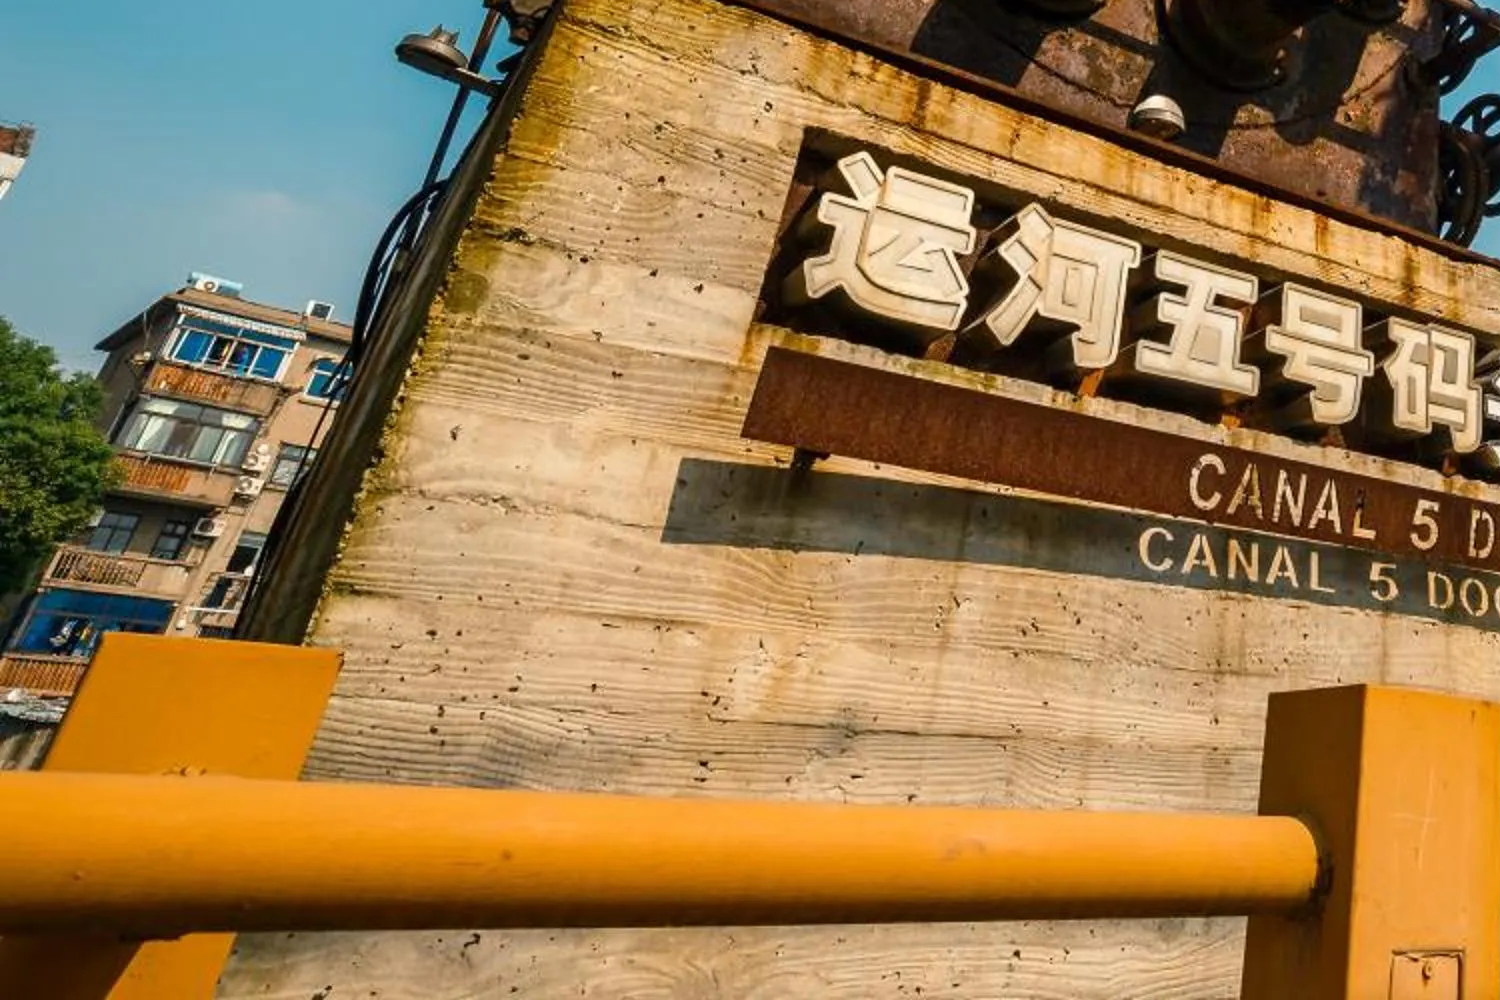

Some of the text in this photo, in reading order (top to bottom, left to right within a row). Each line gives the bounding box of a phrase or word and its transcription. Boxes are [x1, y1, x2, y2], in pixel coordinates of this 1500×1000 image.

[1188, 453, 1376, 541] CANAL
[1410, 500, 1440, 552] 5
[1138, 526, 1336, 594] CANAL
[1370, 562, 1398, 602] 5
